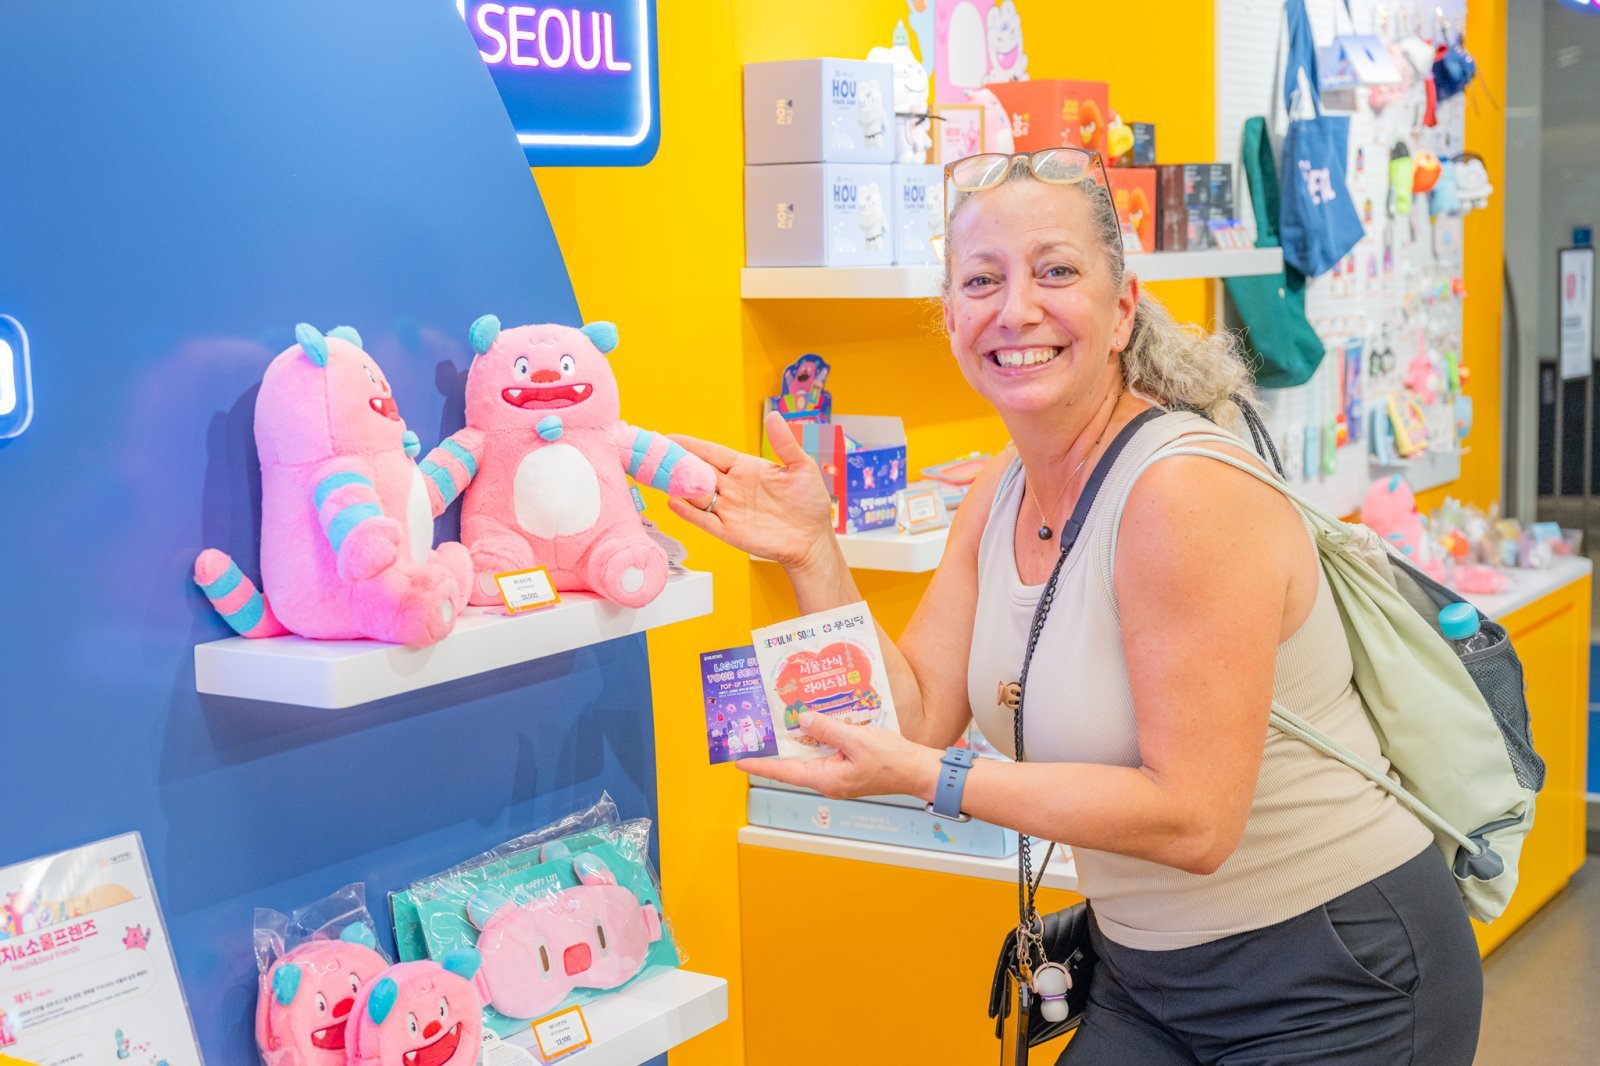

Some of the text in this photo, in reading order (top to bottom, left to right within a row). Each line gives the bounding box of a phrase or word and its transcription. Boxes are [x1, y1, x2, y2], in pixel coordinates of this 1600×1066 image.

[477, 3, 632, 72] SEOUL
[832, 79, 857, 98] HOU
[776, 98, 786, 125] HOU
[833, 184, 857, 203] HOU
[903, 185, 926, 202] HOU
[776, 202, 787, 229] HOU
[714, 659, 745, 672] LIGHT
[800, 654, 843, 674] 서울간식
[707, 667, 761, 683] YOUR SEO
[804, 674, 848, 694] 라이스칩
[721, 682, 741, 690] POP-UP
[0, 919, 98, 966] 지&소울프렌즈
